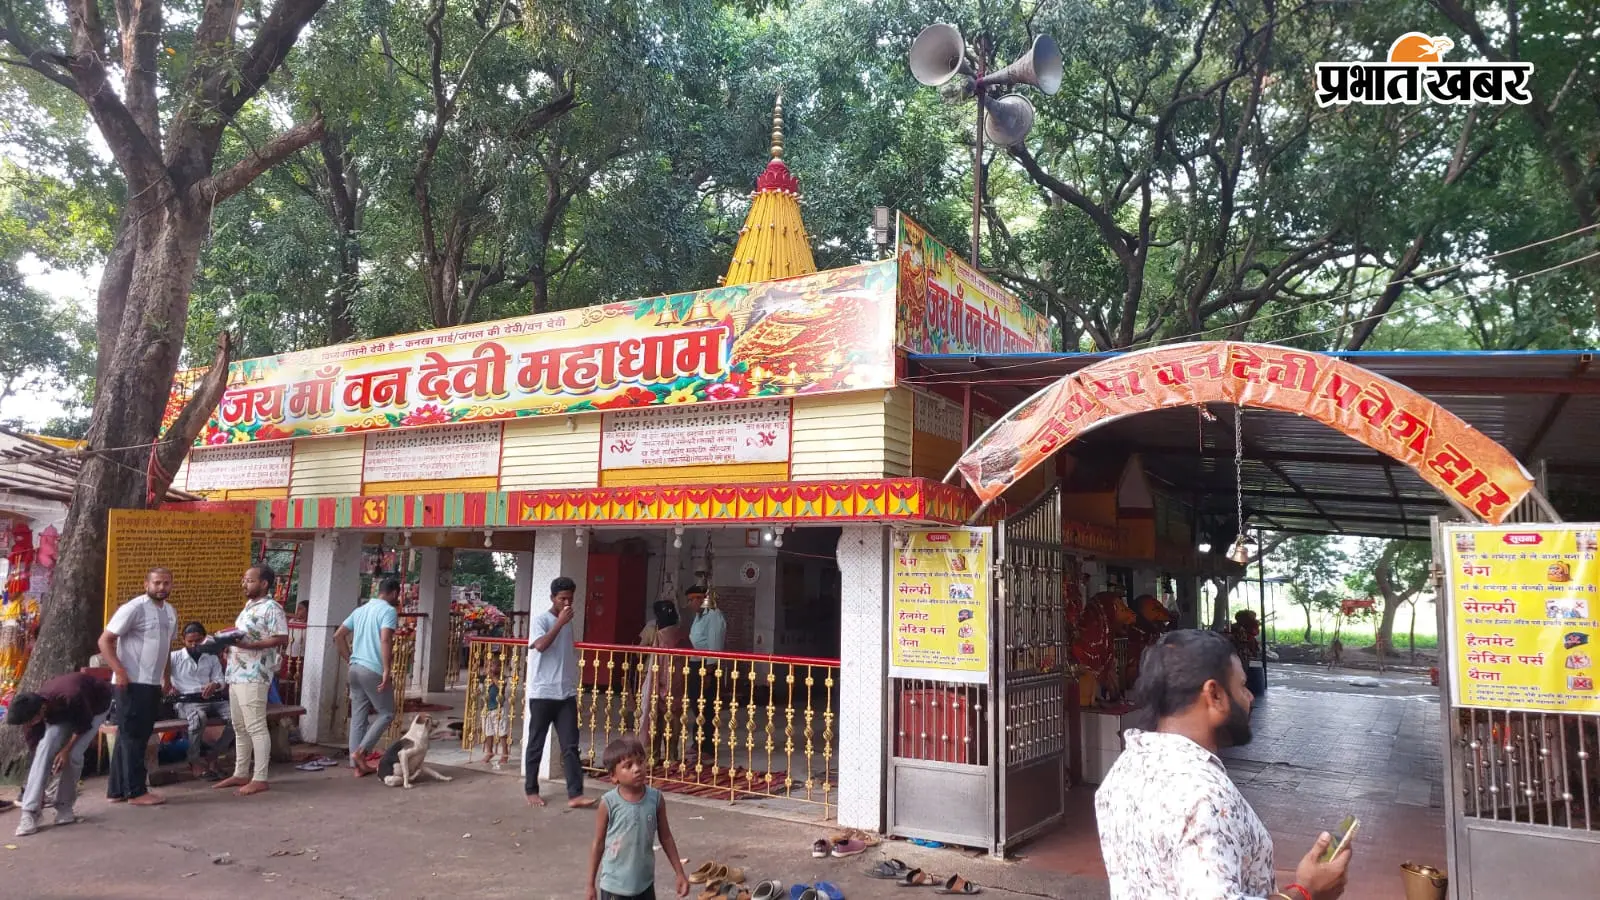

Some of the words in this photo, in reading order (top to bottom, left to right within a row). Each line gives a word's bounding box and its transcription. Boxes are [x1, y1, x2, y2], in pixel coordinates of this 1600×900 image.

[487, 325, 501, 337] की
[222, 384, 287, 424] जय
[290, 366, 341, 415] माँ
[343, 367, 413, 410] वन
[418, 342, 512, 401] देवी
[518, 328, 726, 391] महाधाम
[1026, 392, 1096, 453] जय
[1152, 353, 1224, 386] वन
[1231, 345, 1319, 392] देवी
[1318, 372, 1435, 455] प्रवेश
[1428, 442, 1512, 518] द्वार
[1509, 534, 1537, 544] सूचना
[1462, 561, 1491, 577] बैग
[1463, 597, 1517, 614] सेल्फी
[1467, 650, 1512, 664] लेडिज
[1517, 652, 1544, 666] पर्स
[1468, 668, 1502, 682] थैला
